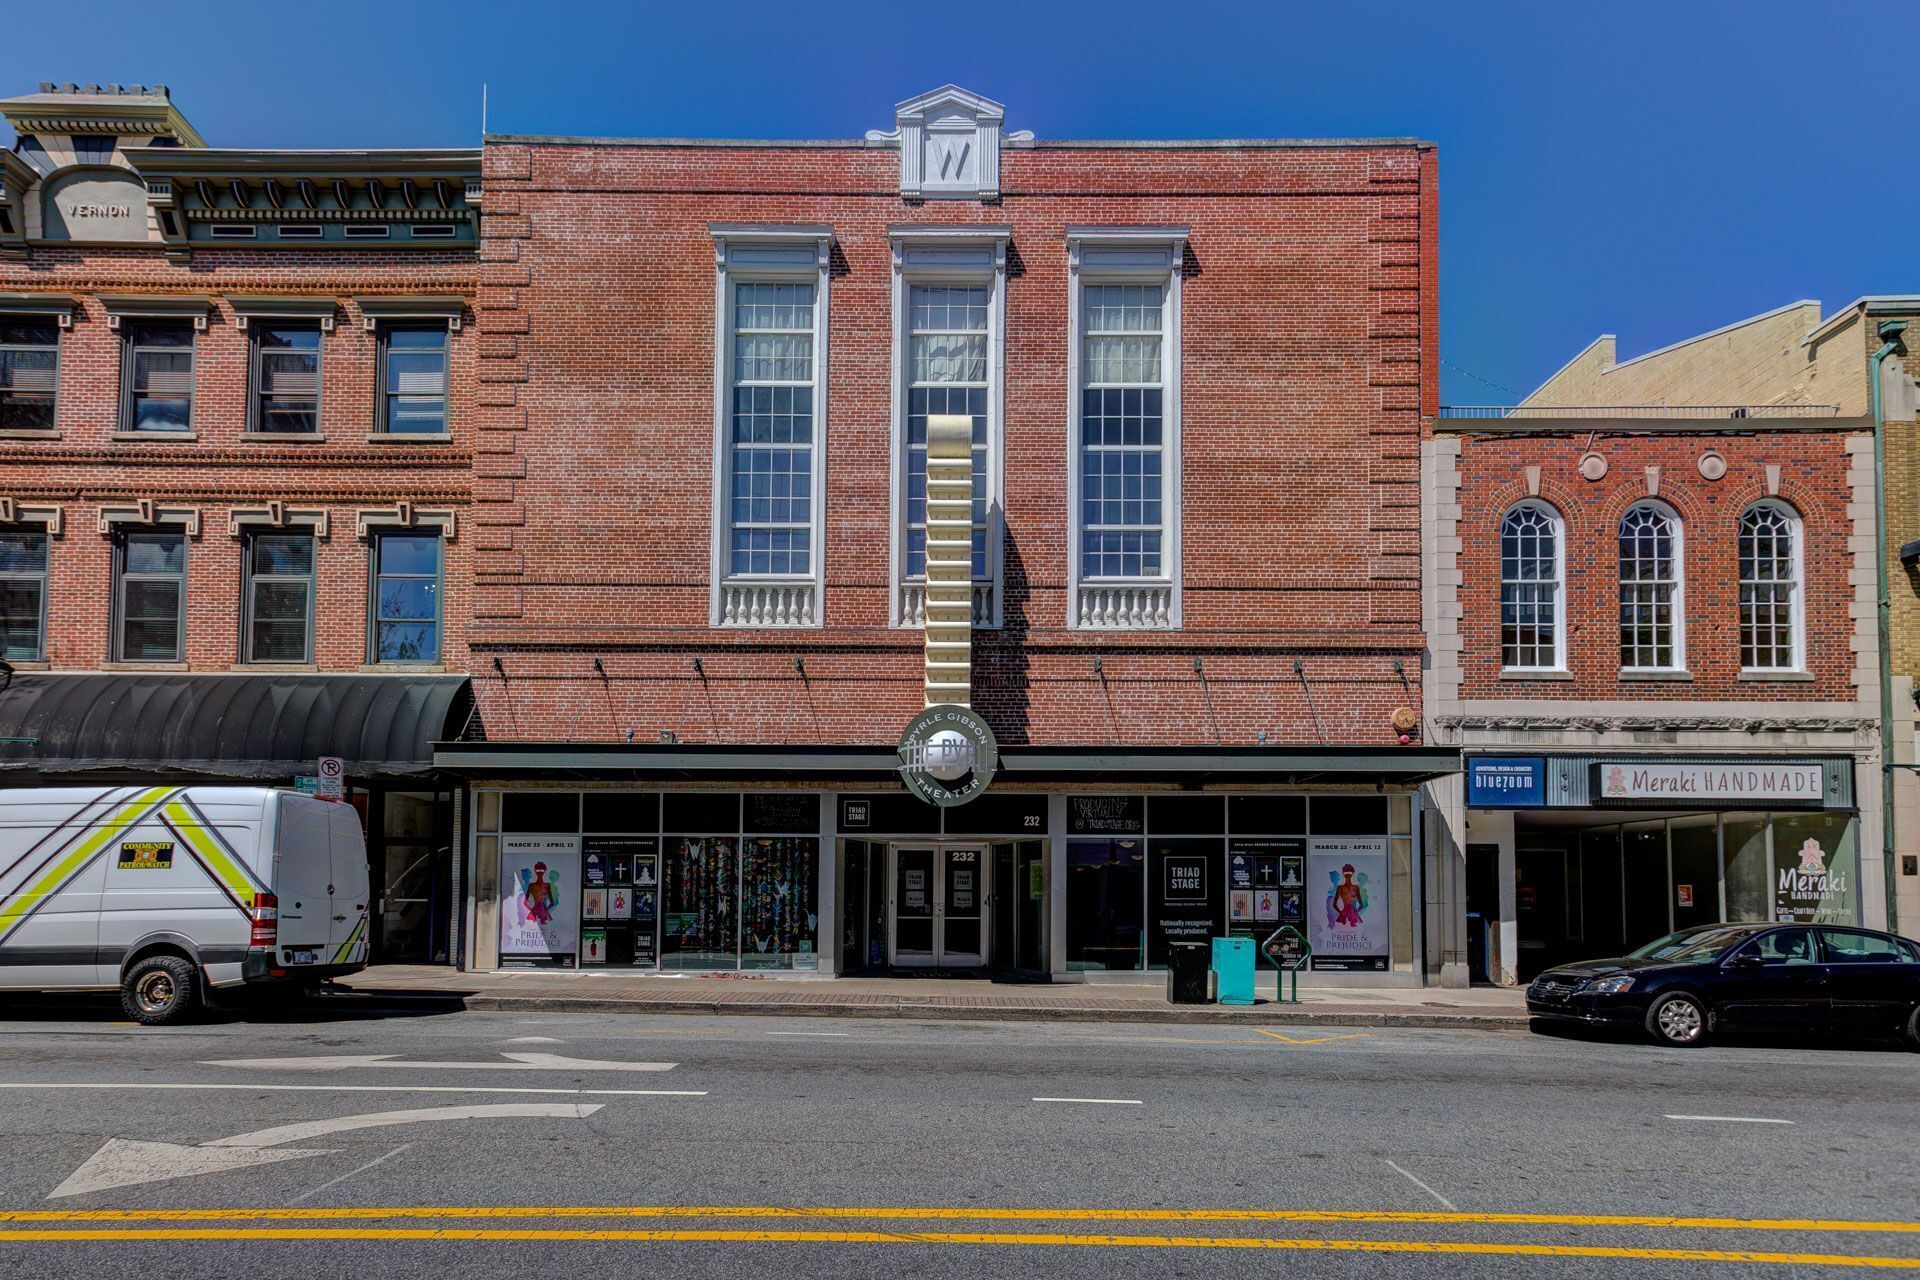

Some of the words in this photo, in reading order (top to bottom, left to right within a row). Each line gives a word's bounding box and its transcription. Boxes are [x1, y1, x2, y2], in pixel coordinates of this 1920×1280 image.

[930, 135, 971, 181] W
[68, 204, 130, 217] VERNON
[909, 713, 943, 741] PYRLE
[947, 712, 988, 745] GIBSON
[904, 739, 934, 773] THE
[296, 777, 303, 787] 2
[1632, 770, 1697, 792] Meraki
[1704, 772, 1817, 792] HANDMADE
[916, 778, 980, 799] THEATER
[1073, 797, 1129, 809] PRODUCING
[1080, 808, 1123, 818] VIRTUALLY
[1023, 815, 1040, 827] 232
[123, 842, 172, 850] COMMUNITY
[952, 852, 975, 861] 232
[1171, 867, 1200, 878] TRIAD
[1171, 879, 1200, 889] STAGE
[1778, 867, 1848, 892] Meraki
[1791, 891, 1834, 900] HANDMADE
[1160, 920, 1184, 928] Nationally
[1185, 920, 1214, 928] recognized.
[520, 931, 546, 939] PRIDE
[550, 930, 558, 939] &
[1331, 933, 1358, 942] PRIDE
[1361, 933, 1368, 942] &
[515, 939, 562, 947] PREJUDICE
[1326, 941, 1374, 950] PREJUDICE
